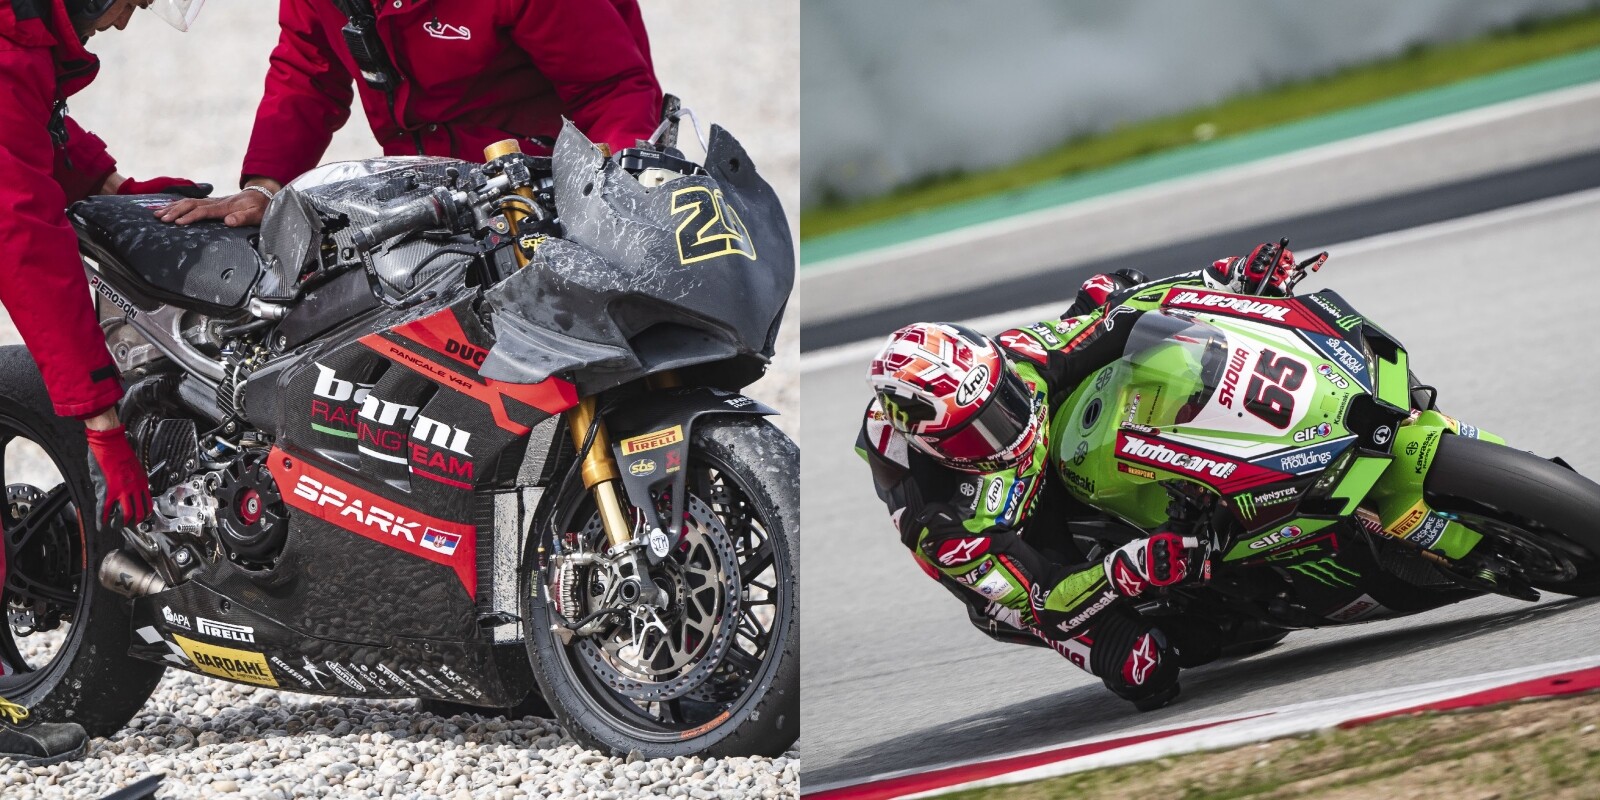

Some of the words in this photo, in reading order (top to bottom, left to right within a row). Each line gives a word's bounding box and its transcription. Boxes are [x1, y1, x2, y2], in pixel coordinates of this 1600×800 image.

[445, 338, 487, 366] DUC
[960, 366, 987, 403] Arai
[1218, 347, 1250, 410] SHOWA
[1243, 348, 1309, 430] 65
[1325, 372, 1350, 389] elf
[628, 430, 676, 452] PIRELLI
[1293, 426, 1318, 442] elf
[1281, 450, 1332, 471] mouldings
[1415, 430, 1438, 474] Kawasaki
[631, 459, 655, 475] sbs
[987, 479, 1002, 511] Arai
[294, 475, 421, 543] SPARK
[1390, 509, 1424, 535] PIRELLI
[1249, 532, 1281, 549] elf
[1411, 517, 1436, 543] CHESHIRE
[1056, 590, 1119, 633] Kawasak
[196, 616, 256, 643] PIRELLI
[192, 650, 269, 678] BARDAHL
